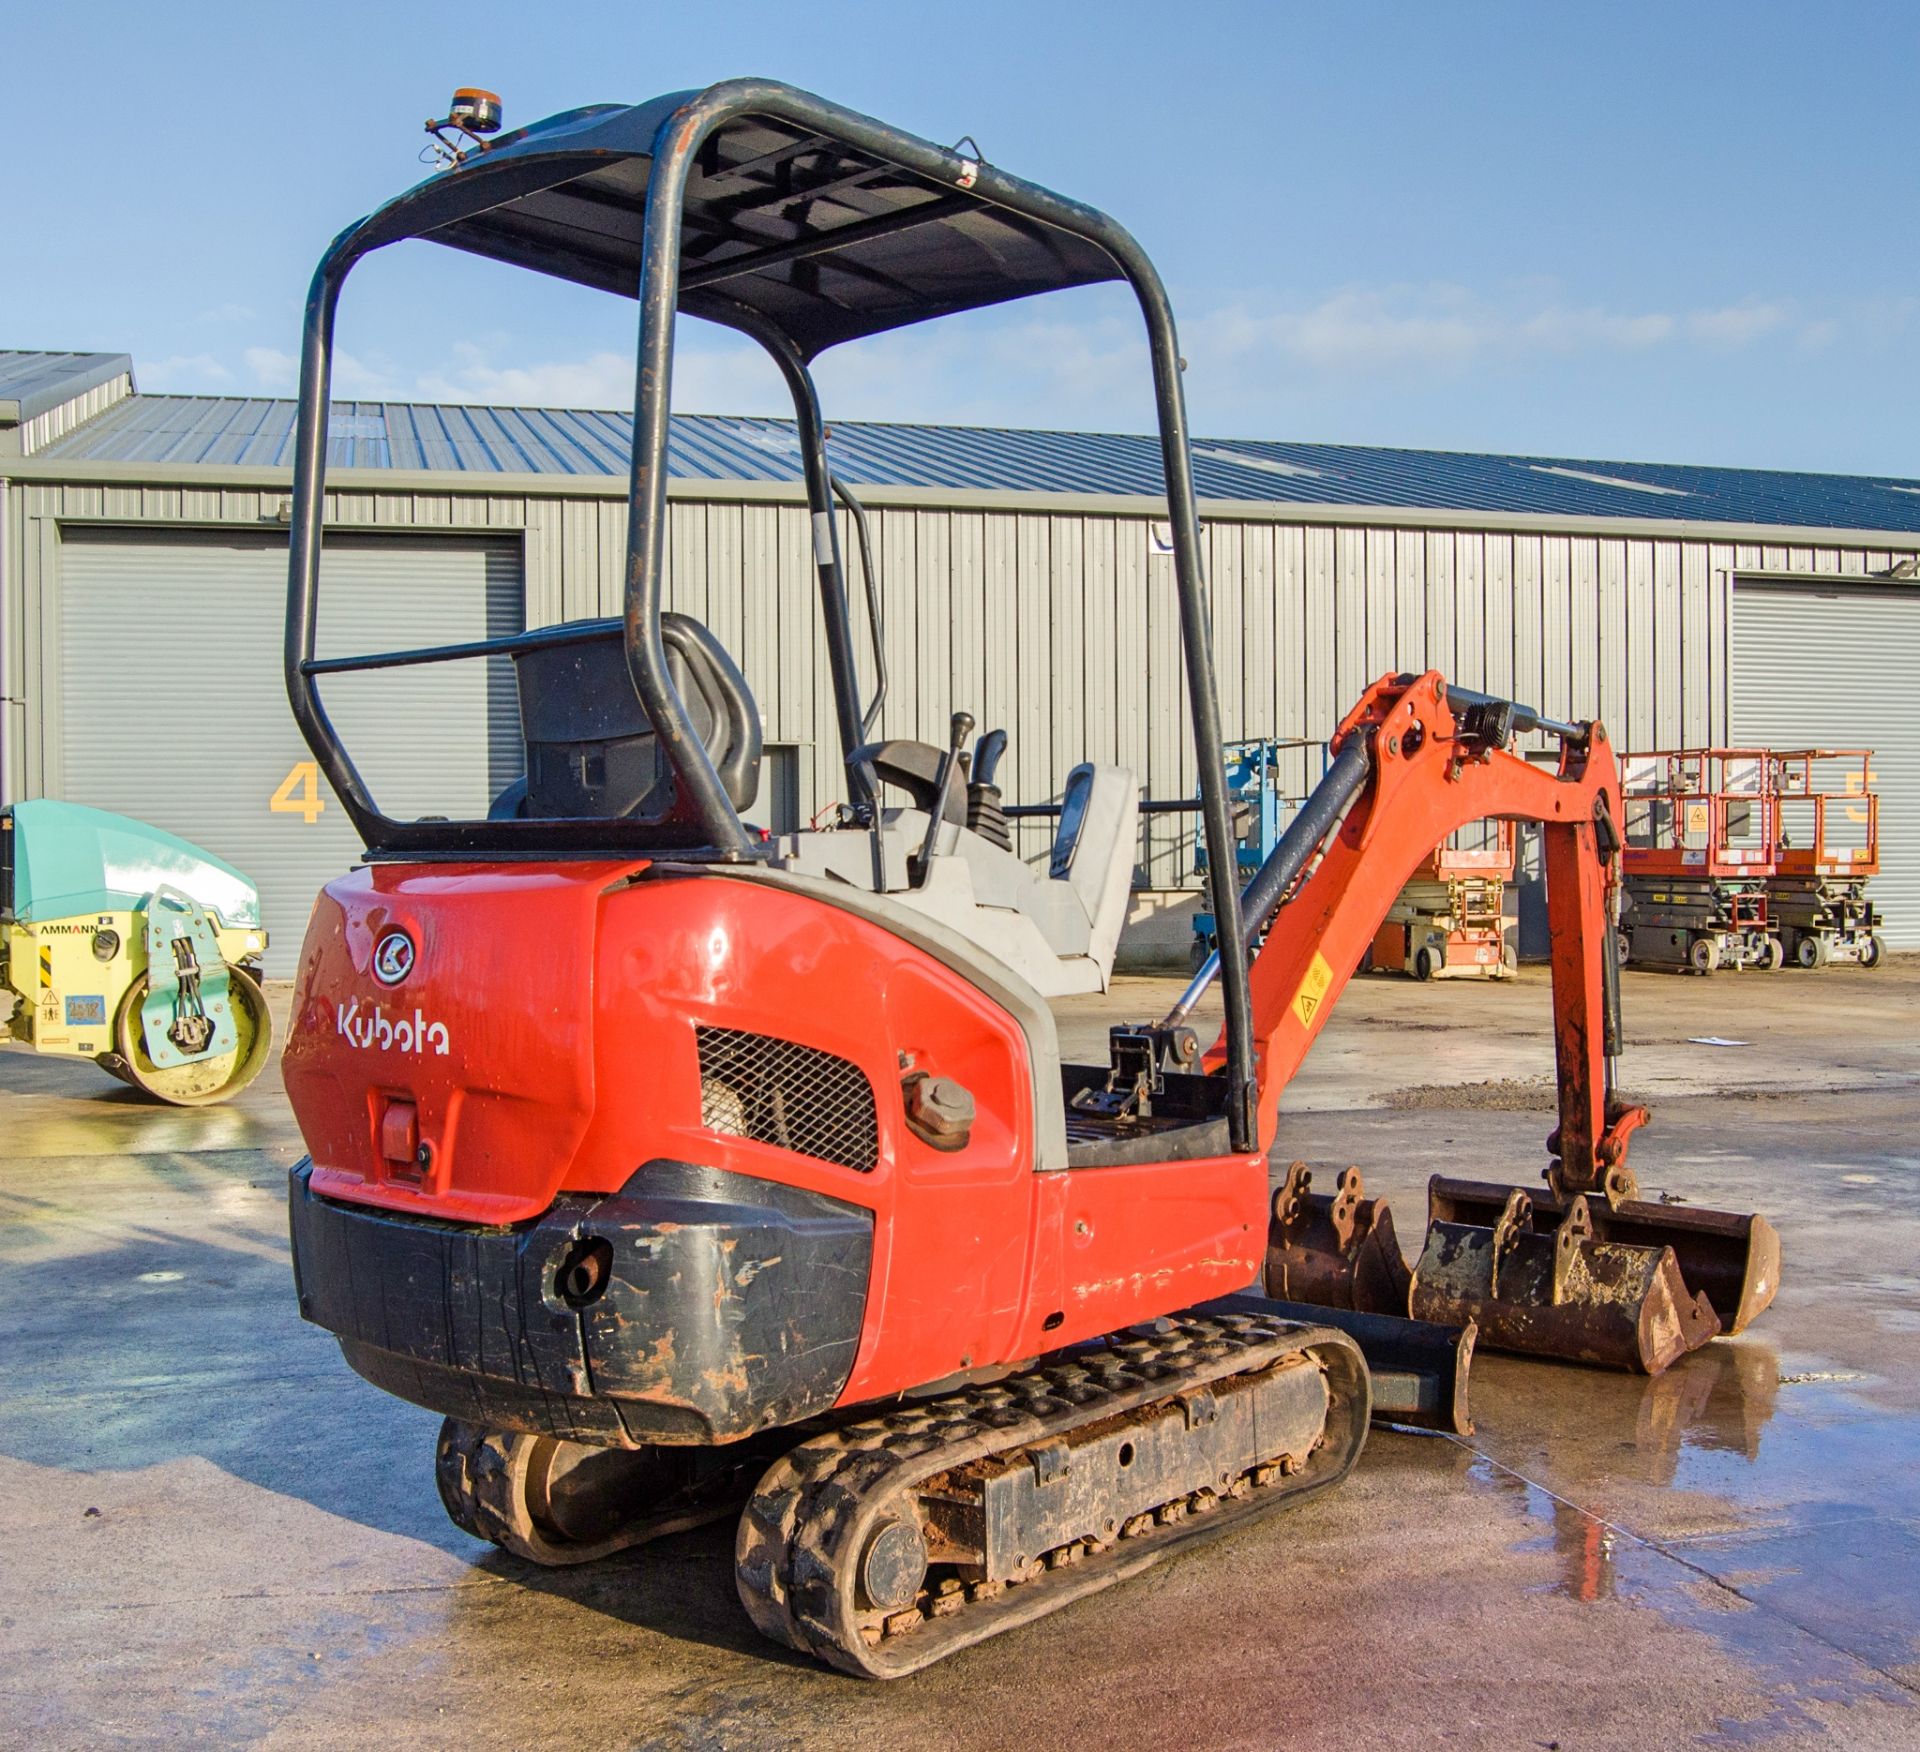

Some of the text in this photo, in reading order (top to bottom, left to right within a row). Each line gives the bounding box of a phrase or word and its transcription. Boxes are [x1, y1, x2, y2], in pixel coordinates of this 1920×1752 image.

[270, 761, 325, 824] 4
[40, 925, 99, 935] AMMANN
[337, 1003, 449, 1055] Kubota
